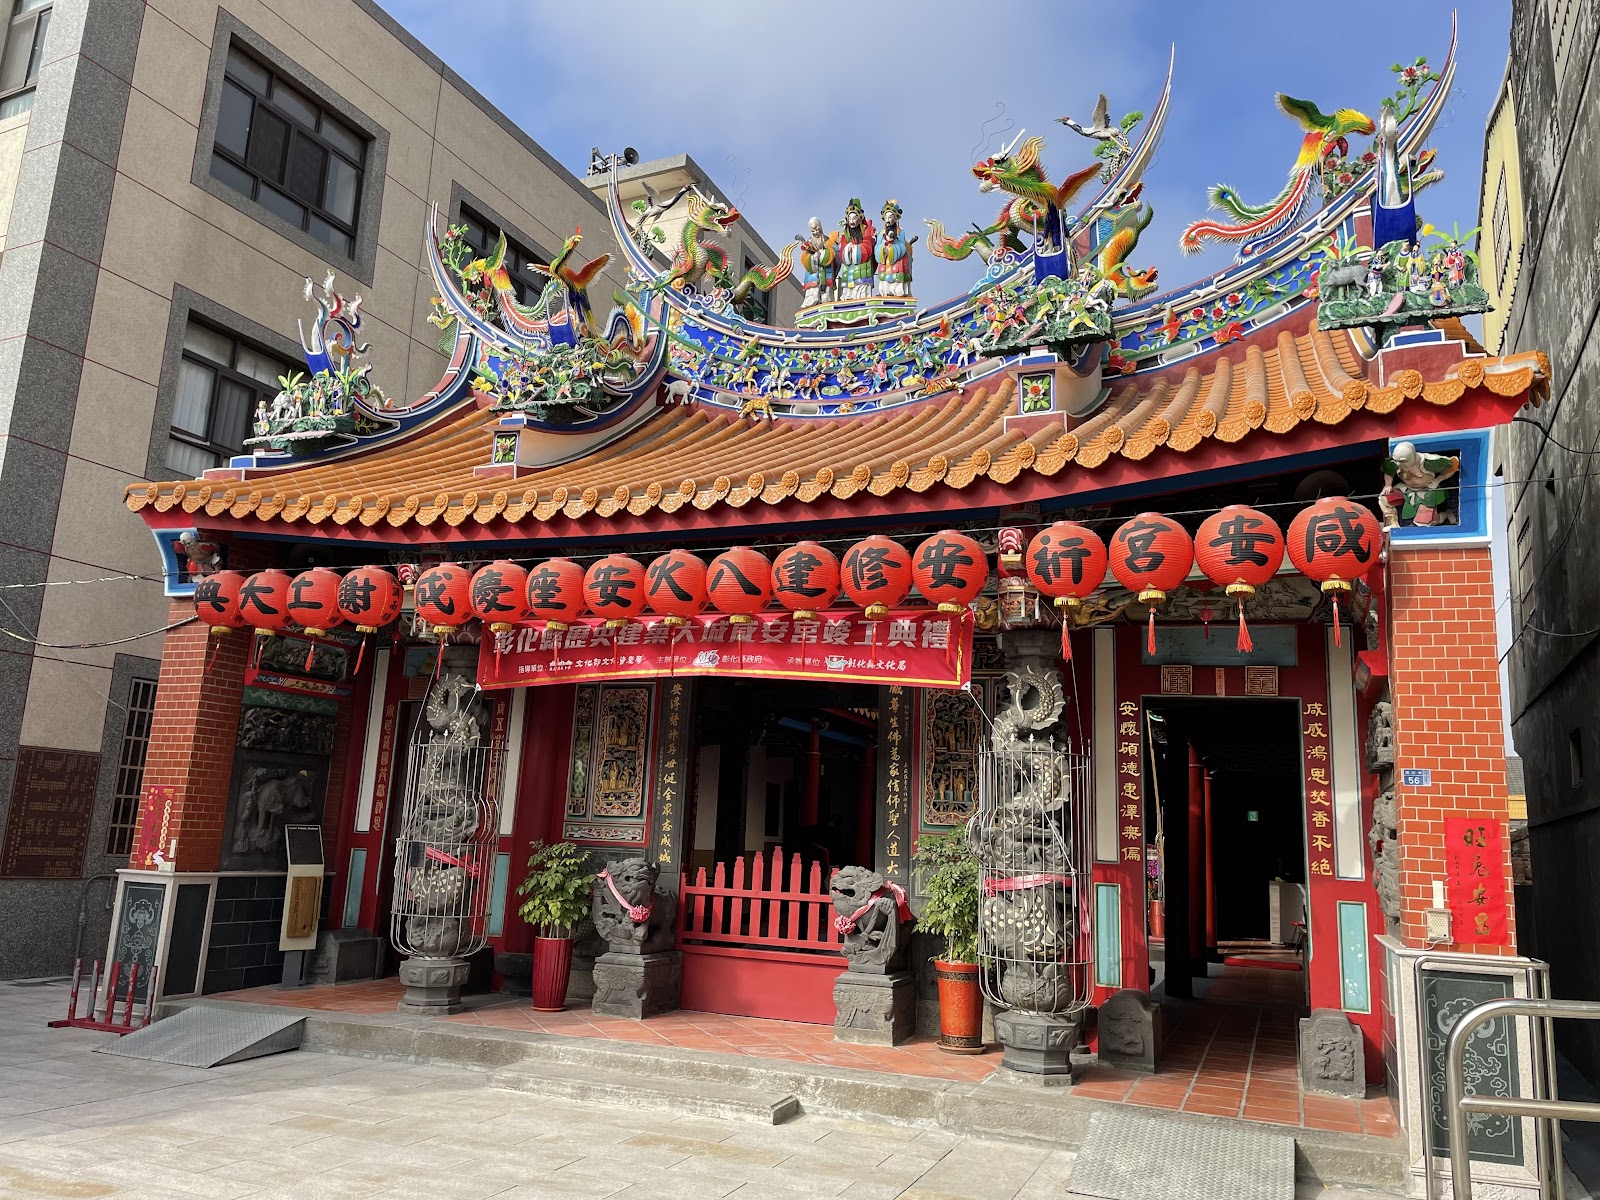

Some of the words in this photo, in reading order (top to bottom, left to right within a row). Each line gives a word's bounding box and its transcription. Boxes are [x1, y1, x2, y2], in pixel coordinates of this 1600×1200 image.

[1118, 520, 1173, 574] 宮
[1208, 514, 1276, 567] 安
[1304, 505, 1371, 564] 咸
[648, 556, 693, 602] 火
[774, 550, 827, 598] 建
[846, 546, 902, 591] 修
[917, 538, 974, 589] 安
[1033, 534, 1092, 585] 祈
[194, 578, 230, 613] 典
[239, 576, 279, 615] 大
[338, 575, 377, 615] 謝
[415, 570, 455, 615] 成
[471, 568, 516, 613] 慶
[529, 567, 567, 610] 座
[588, 564, 636, 608] 安
[1408, 776, 1420, 785] 56
